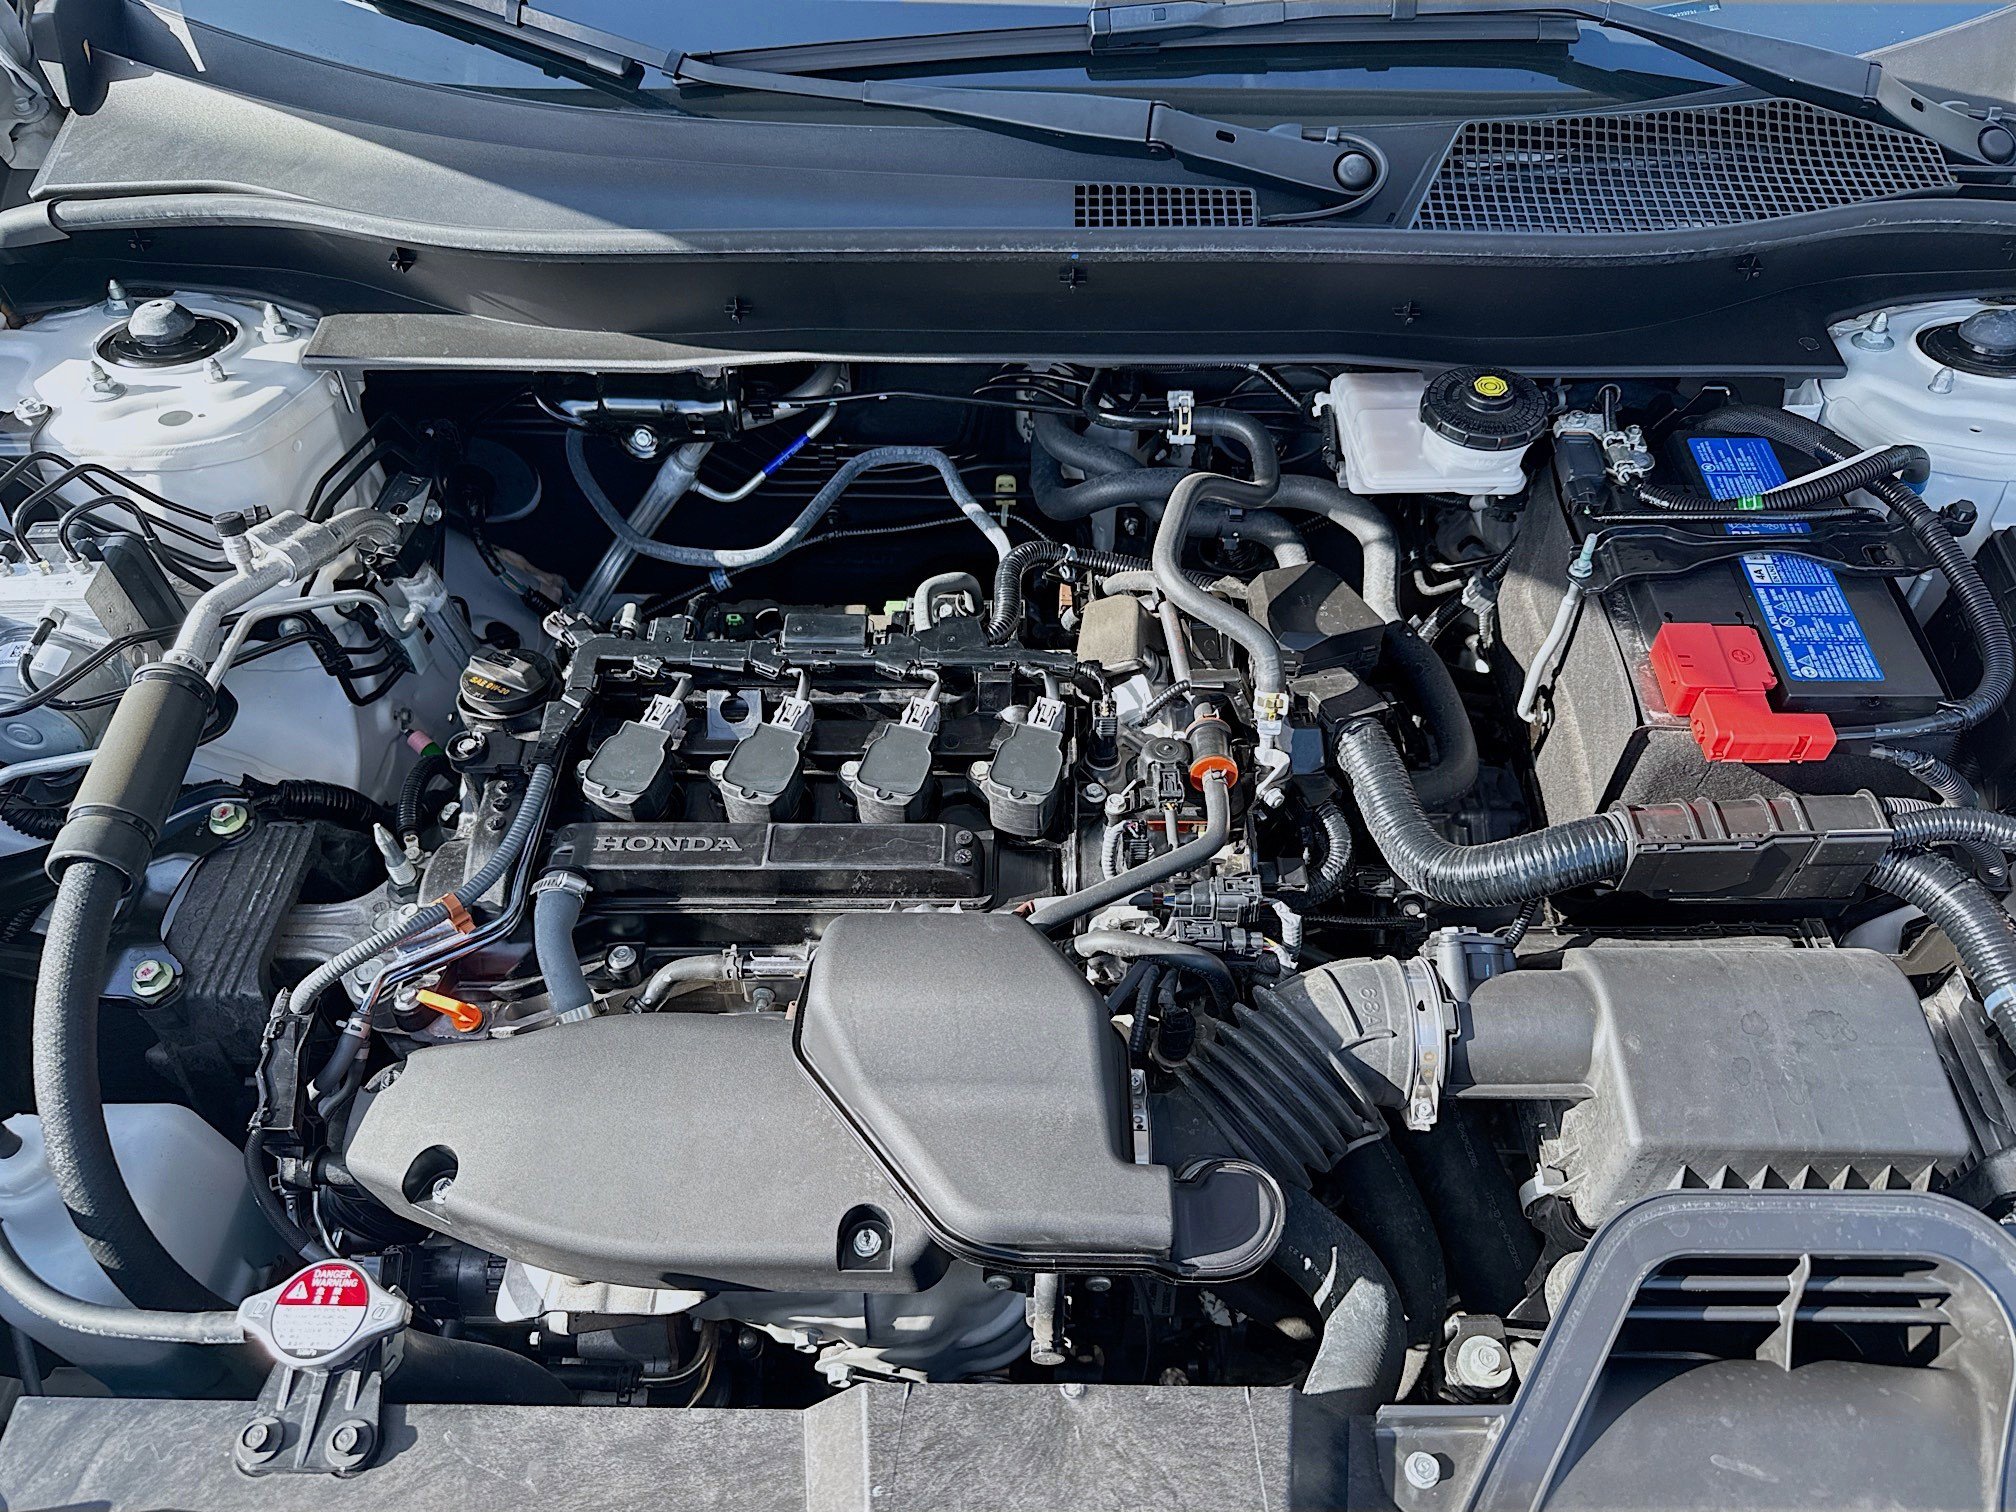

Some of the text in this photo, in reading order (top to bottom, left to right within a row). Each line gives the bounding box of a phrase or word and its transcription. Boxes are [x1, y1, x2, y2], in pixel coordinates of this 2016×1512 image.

[1753, 568, 1765, 580] 4A
[469, 676, 487, 687] SAE
[592, 836, 743, 852] HONDA
[314, 1269, 352, 1278] DANGER
[312, 1278, 358, 1287] WARNUNG
